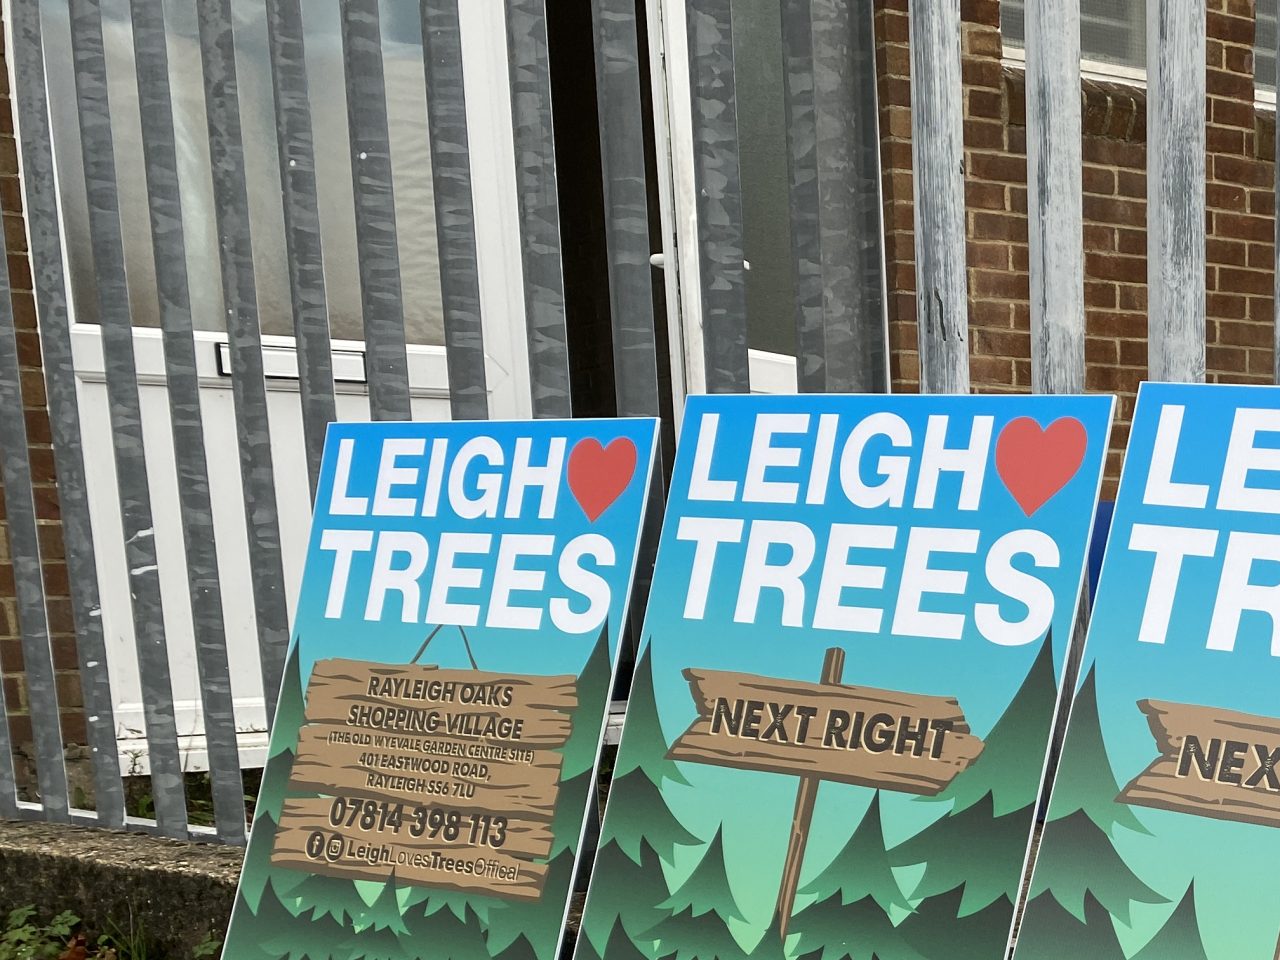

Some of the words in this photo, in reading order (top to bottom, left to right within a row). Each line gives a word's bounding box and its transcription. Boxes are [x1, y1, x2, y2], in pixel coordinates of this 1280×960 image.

[330, 436, 568, 520] LEIGH
[688, 412, 994, 511] LEIGH
[321, 528, 616, 636] TREES
[677, 515, 1060, 648] TREES
[367, 677, 455, 703] RAYLEIGH
[460, 682, 513, 707] OAKS
[327, 731, 351, 745] (THE
[351, 733, 371, 746] OLD
[374, 735, 421, 752] WYEVALE
[420, 740, 466, 756] GARDEN
[466, 744, 508, 760] CENTRE
[508, 748, 535, 764] SITE)
[346, 704, 440, 732] SHOPPING
[444, 714, 524, 741] VILLAGE
[710, 696, 820, 750] NEXT
[823, 708, 955, 761] RIGHT
[358, 752, 378, 767] 401
[377, 755, 449, 774] EASTWOOD
[451, 762, 492, 781] ROAD,
[366, 773, 425, 794] RAYLEIGH
[426, 779, 448, 796] SS6
[451, 782, 475, 800] 7LU
[328, 796, 403, 836] 07814
[408, 807, 461, 843] 398
[467, 812, 509, 849] 113
